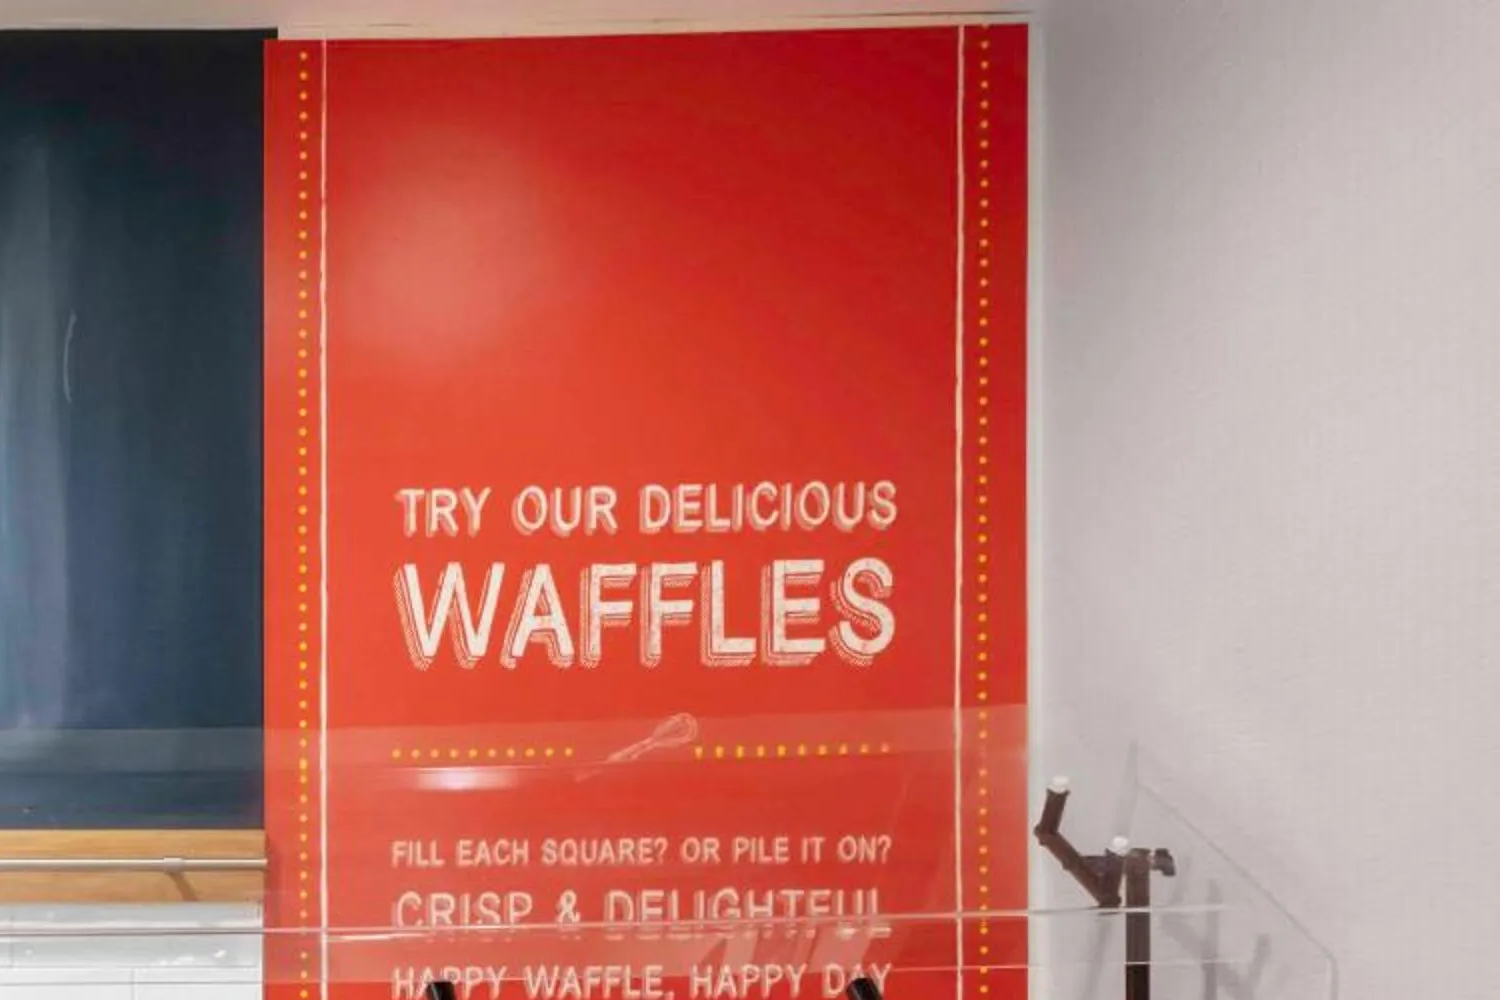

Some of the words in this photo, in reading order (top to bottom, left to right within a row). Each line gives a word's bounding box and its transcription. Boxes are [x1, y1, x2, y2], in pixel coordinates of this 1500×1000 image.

[394, 486, 491, 537] TRY
[512, 485, 618, 535] OUR
[639, 480, 898, 534] DELICIOUS
[394, 557, 896, 670] WAFFLES
[392, 840, 444, 867] FILL
[456, 839, 529, 867] EACH
[542, 837, 668, 866] SQUARE?
[682, 837, 720, 864] OR
[733, 836, 789, 863] PILE
[801, 835, 826, 863] IT
[838, 835, 892, 863] ON?
[393, 890, 533, 941] CRISP
[558, 889, 582, 939] &
[604, 887, 892, 940] DELIGHTFUL
[392, 966, 507, 1000] HAPPY
[690, 964, 804, 1000] HAPPY
